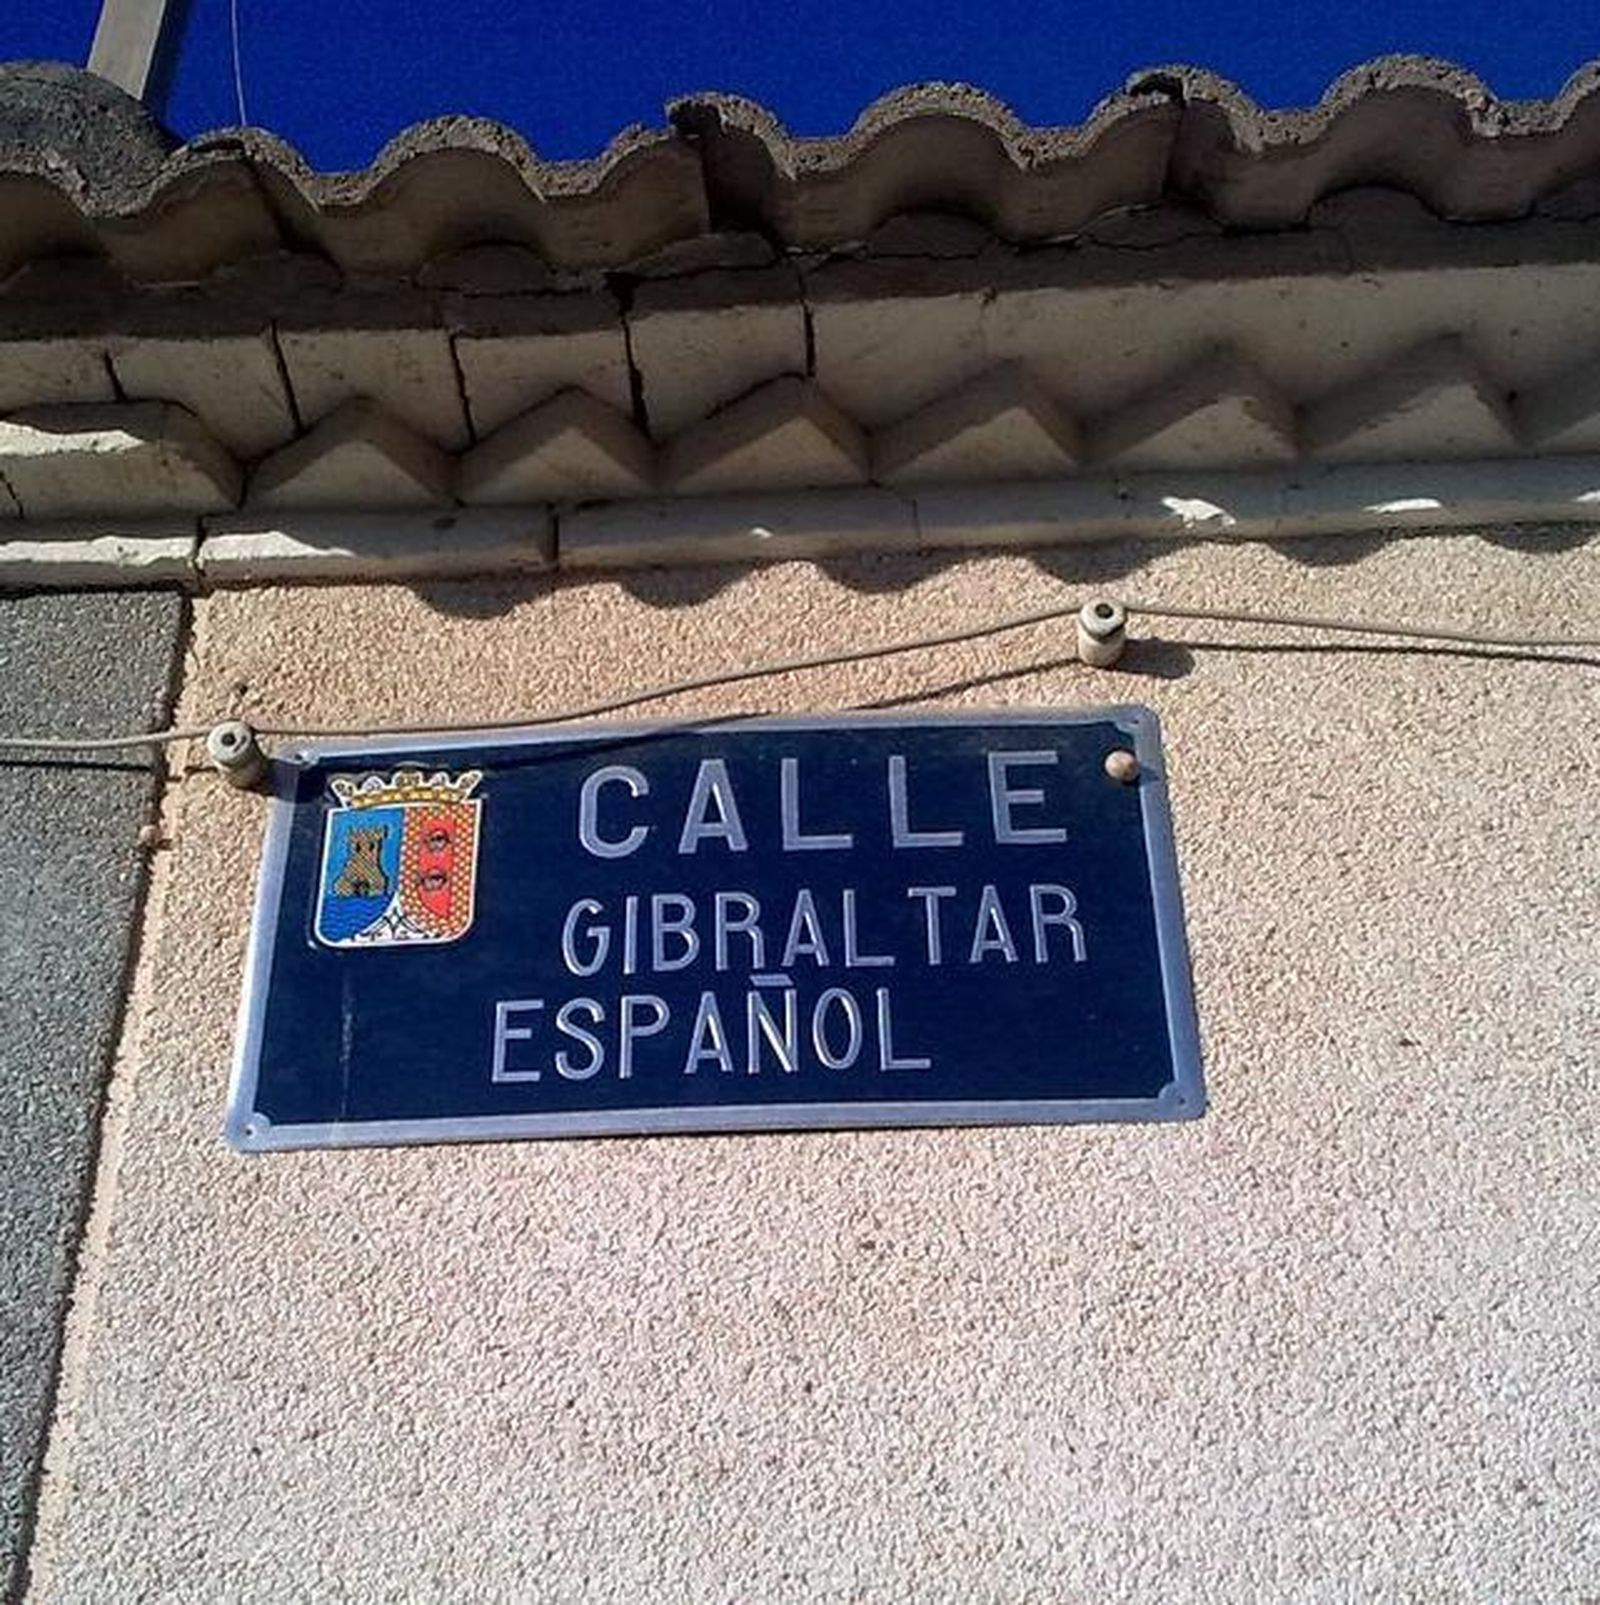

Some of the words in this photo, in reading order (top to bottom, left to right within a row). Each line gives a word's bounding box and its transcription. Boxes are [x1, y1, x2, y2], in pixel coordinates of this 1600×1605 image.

[578, 750, 1067, 859] CALLE
[562, 884, 1087, 977] GIBRALTAR
[491, 973, 932, 1083] ESPAÑOL
